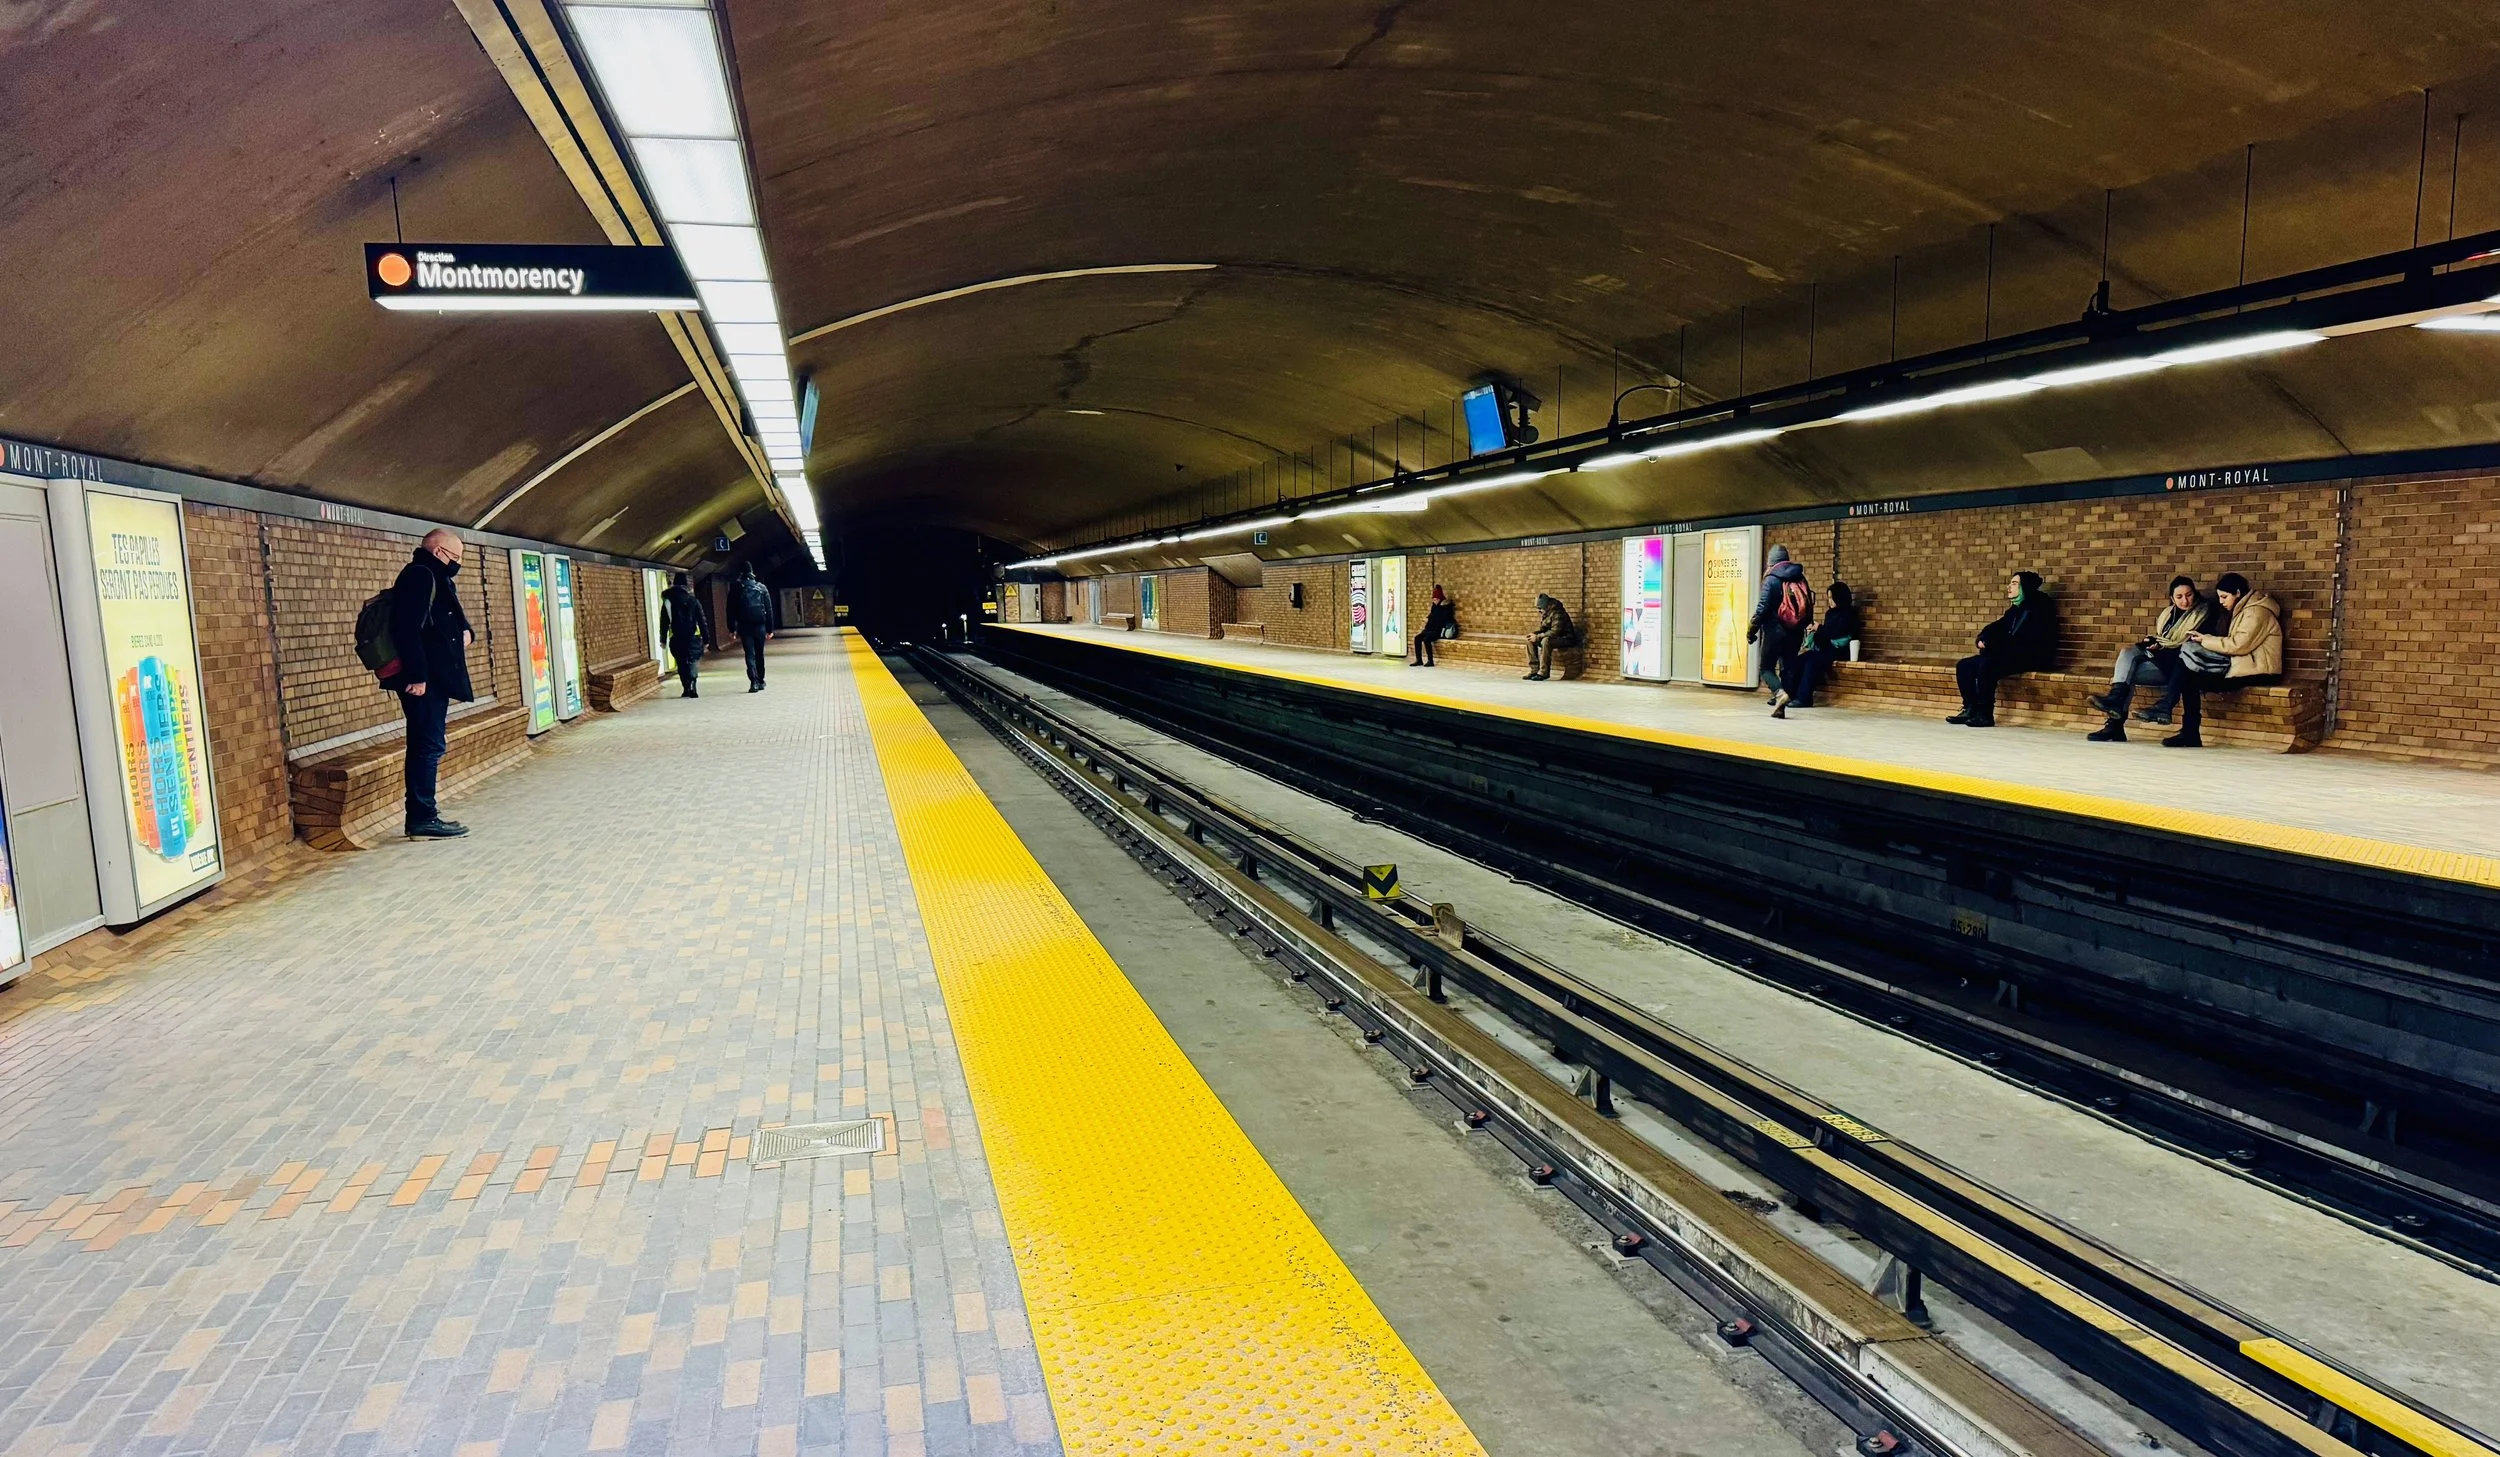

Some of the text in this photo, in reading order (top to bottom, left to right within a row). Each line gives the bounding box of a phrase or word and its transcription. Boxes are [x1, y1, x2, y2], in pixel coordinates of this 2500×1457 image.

[418, 251, 455, 262] Direction
[417, 262, 584, 295] Montmorency
[9, 444, 104, 482] MONT-ROYAL
[2178, 468, 2269, 489] MONT-ROYAL
[326, 503, 364, 525] MONT-ROYAL
[1856, 500, 1910, 515] MONT-ROYAL
[1657, 522, 1692, 534] MONT-ROYAL
[112, 533, 160, 566] TES PAPILLES
[1707, 559, 1713, 579] 8
[100, 568, 179, 601] SERONT PAS PERDUES
[150, 737, 169, 816] HORS
